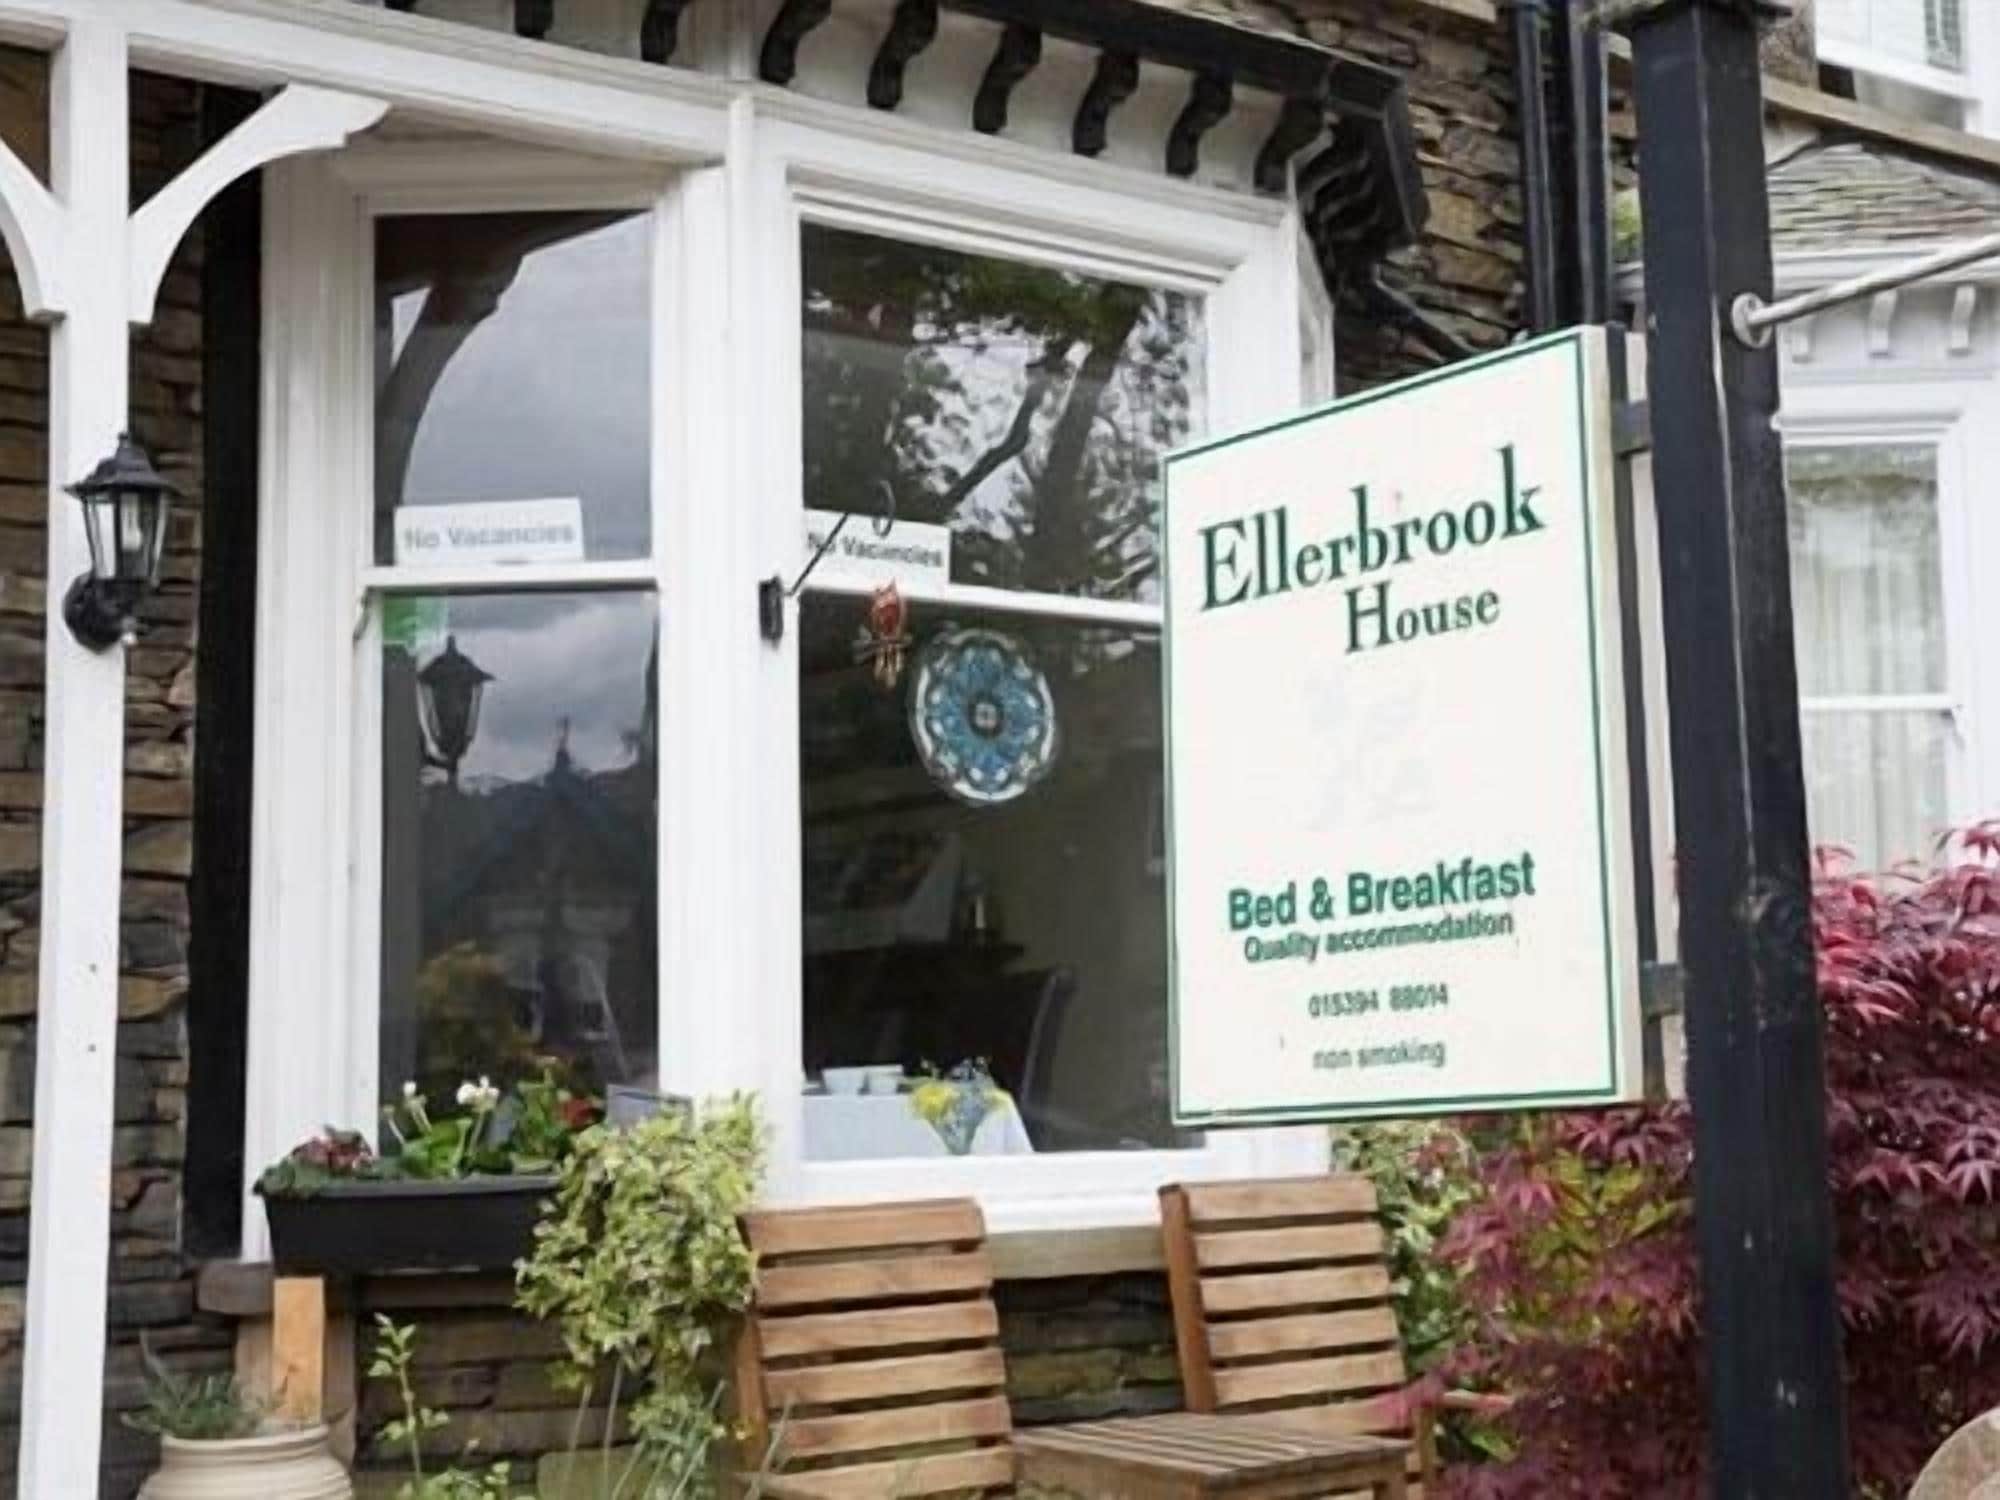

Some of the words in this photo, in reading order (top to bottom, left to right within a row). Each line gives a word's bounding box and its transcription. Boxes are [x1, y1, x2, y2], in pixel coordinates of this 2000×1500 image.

[404, 528, 442, 551] No
[1198, 443, 1546, 613] Ellerbrook
[1345, 579, 1501, 655] House
[1229, 881, 1297, 931] Bed
[1309, 877, 1335, 922] &
[1347, 851, 1536, 917] Breakfast
[1245, 931, 1319, 962] Quality
[1325, 910, 1514, 955] accommodation
